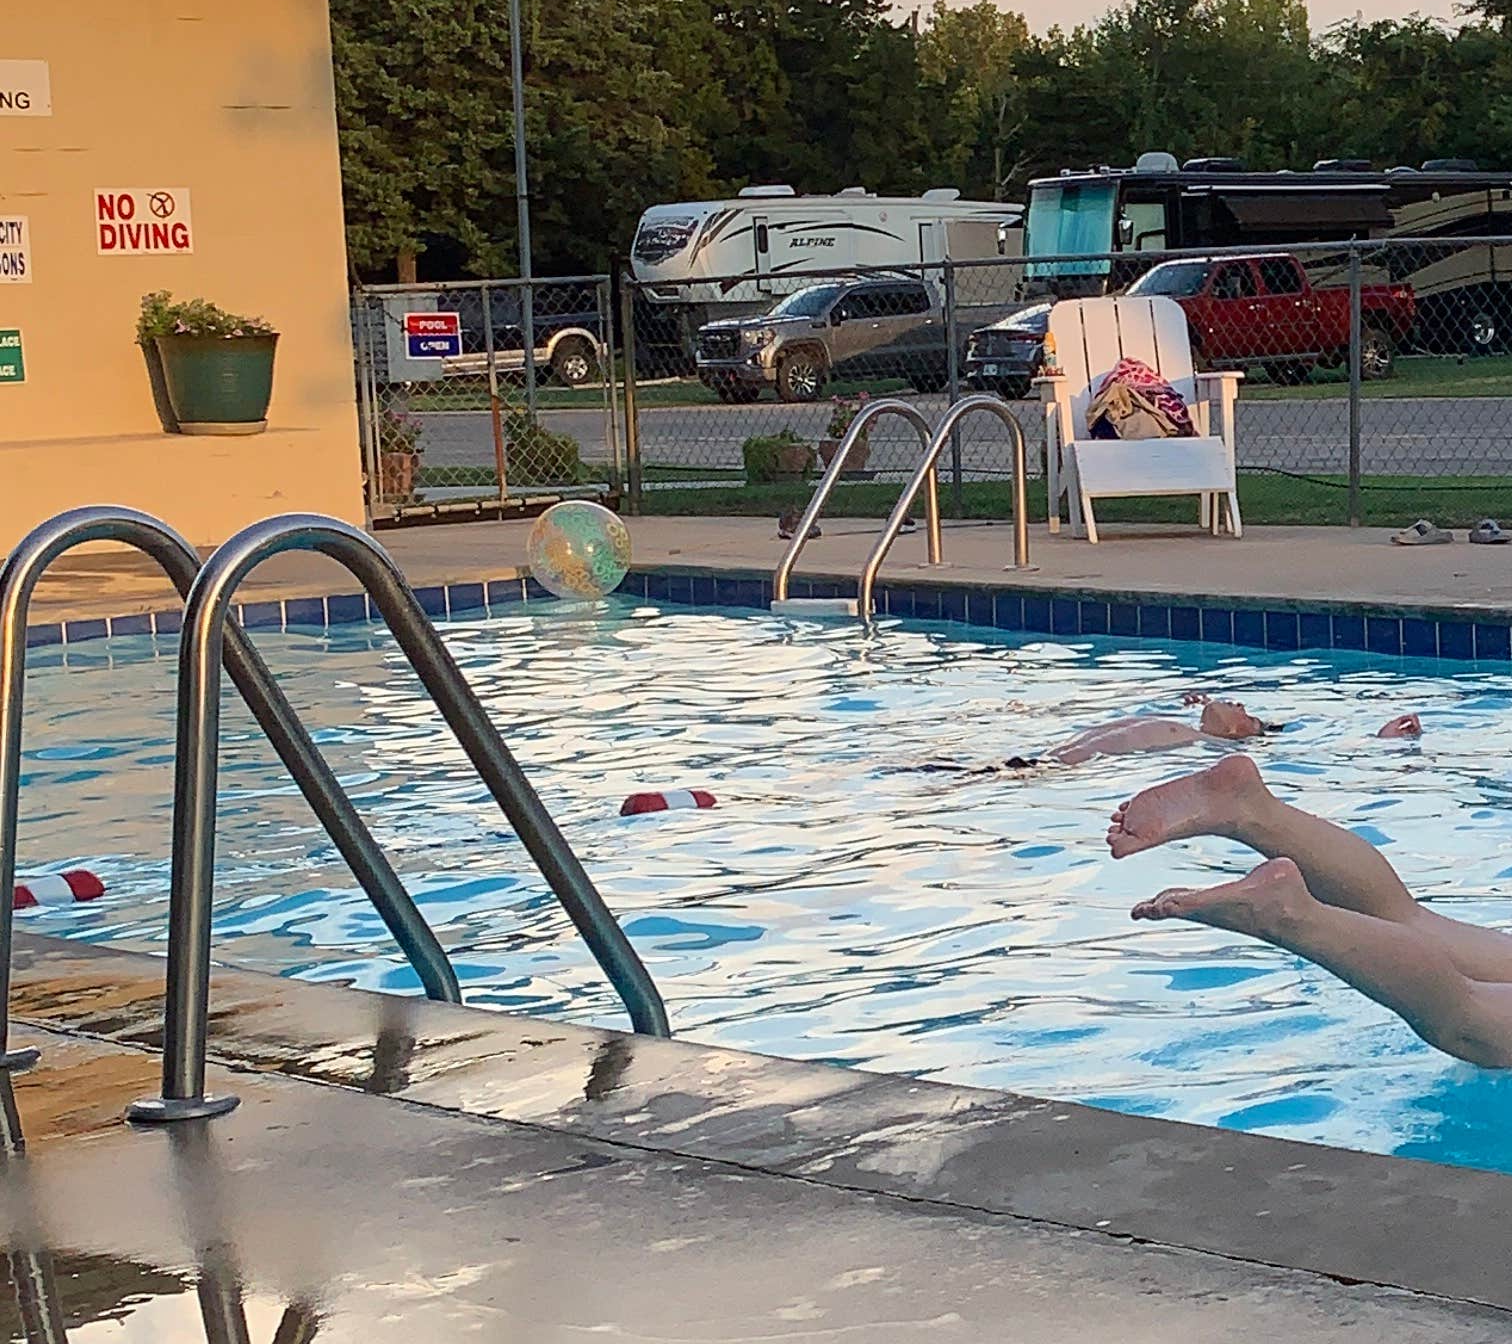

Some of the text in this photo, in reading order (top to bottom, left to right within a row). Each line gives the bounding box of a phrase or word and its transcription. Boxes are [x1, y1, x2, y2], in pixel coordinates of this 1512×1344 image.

[98, 194, 135, 220] NO
[100, 223, 190, 250] DIVING
[789, 238, 836, 248] ALPINE
[0, 252, 25, 275] ONS
[419, 321, 448, 330] POOL
[0, 336, 20, 347] ACE
